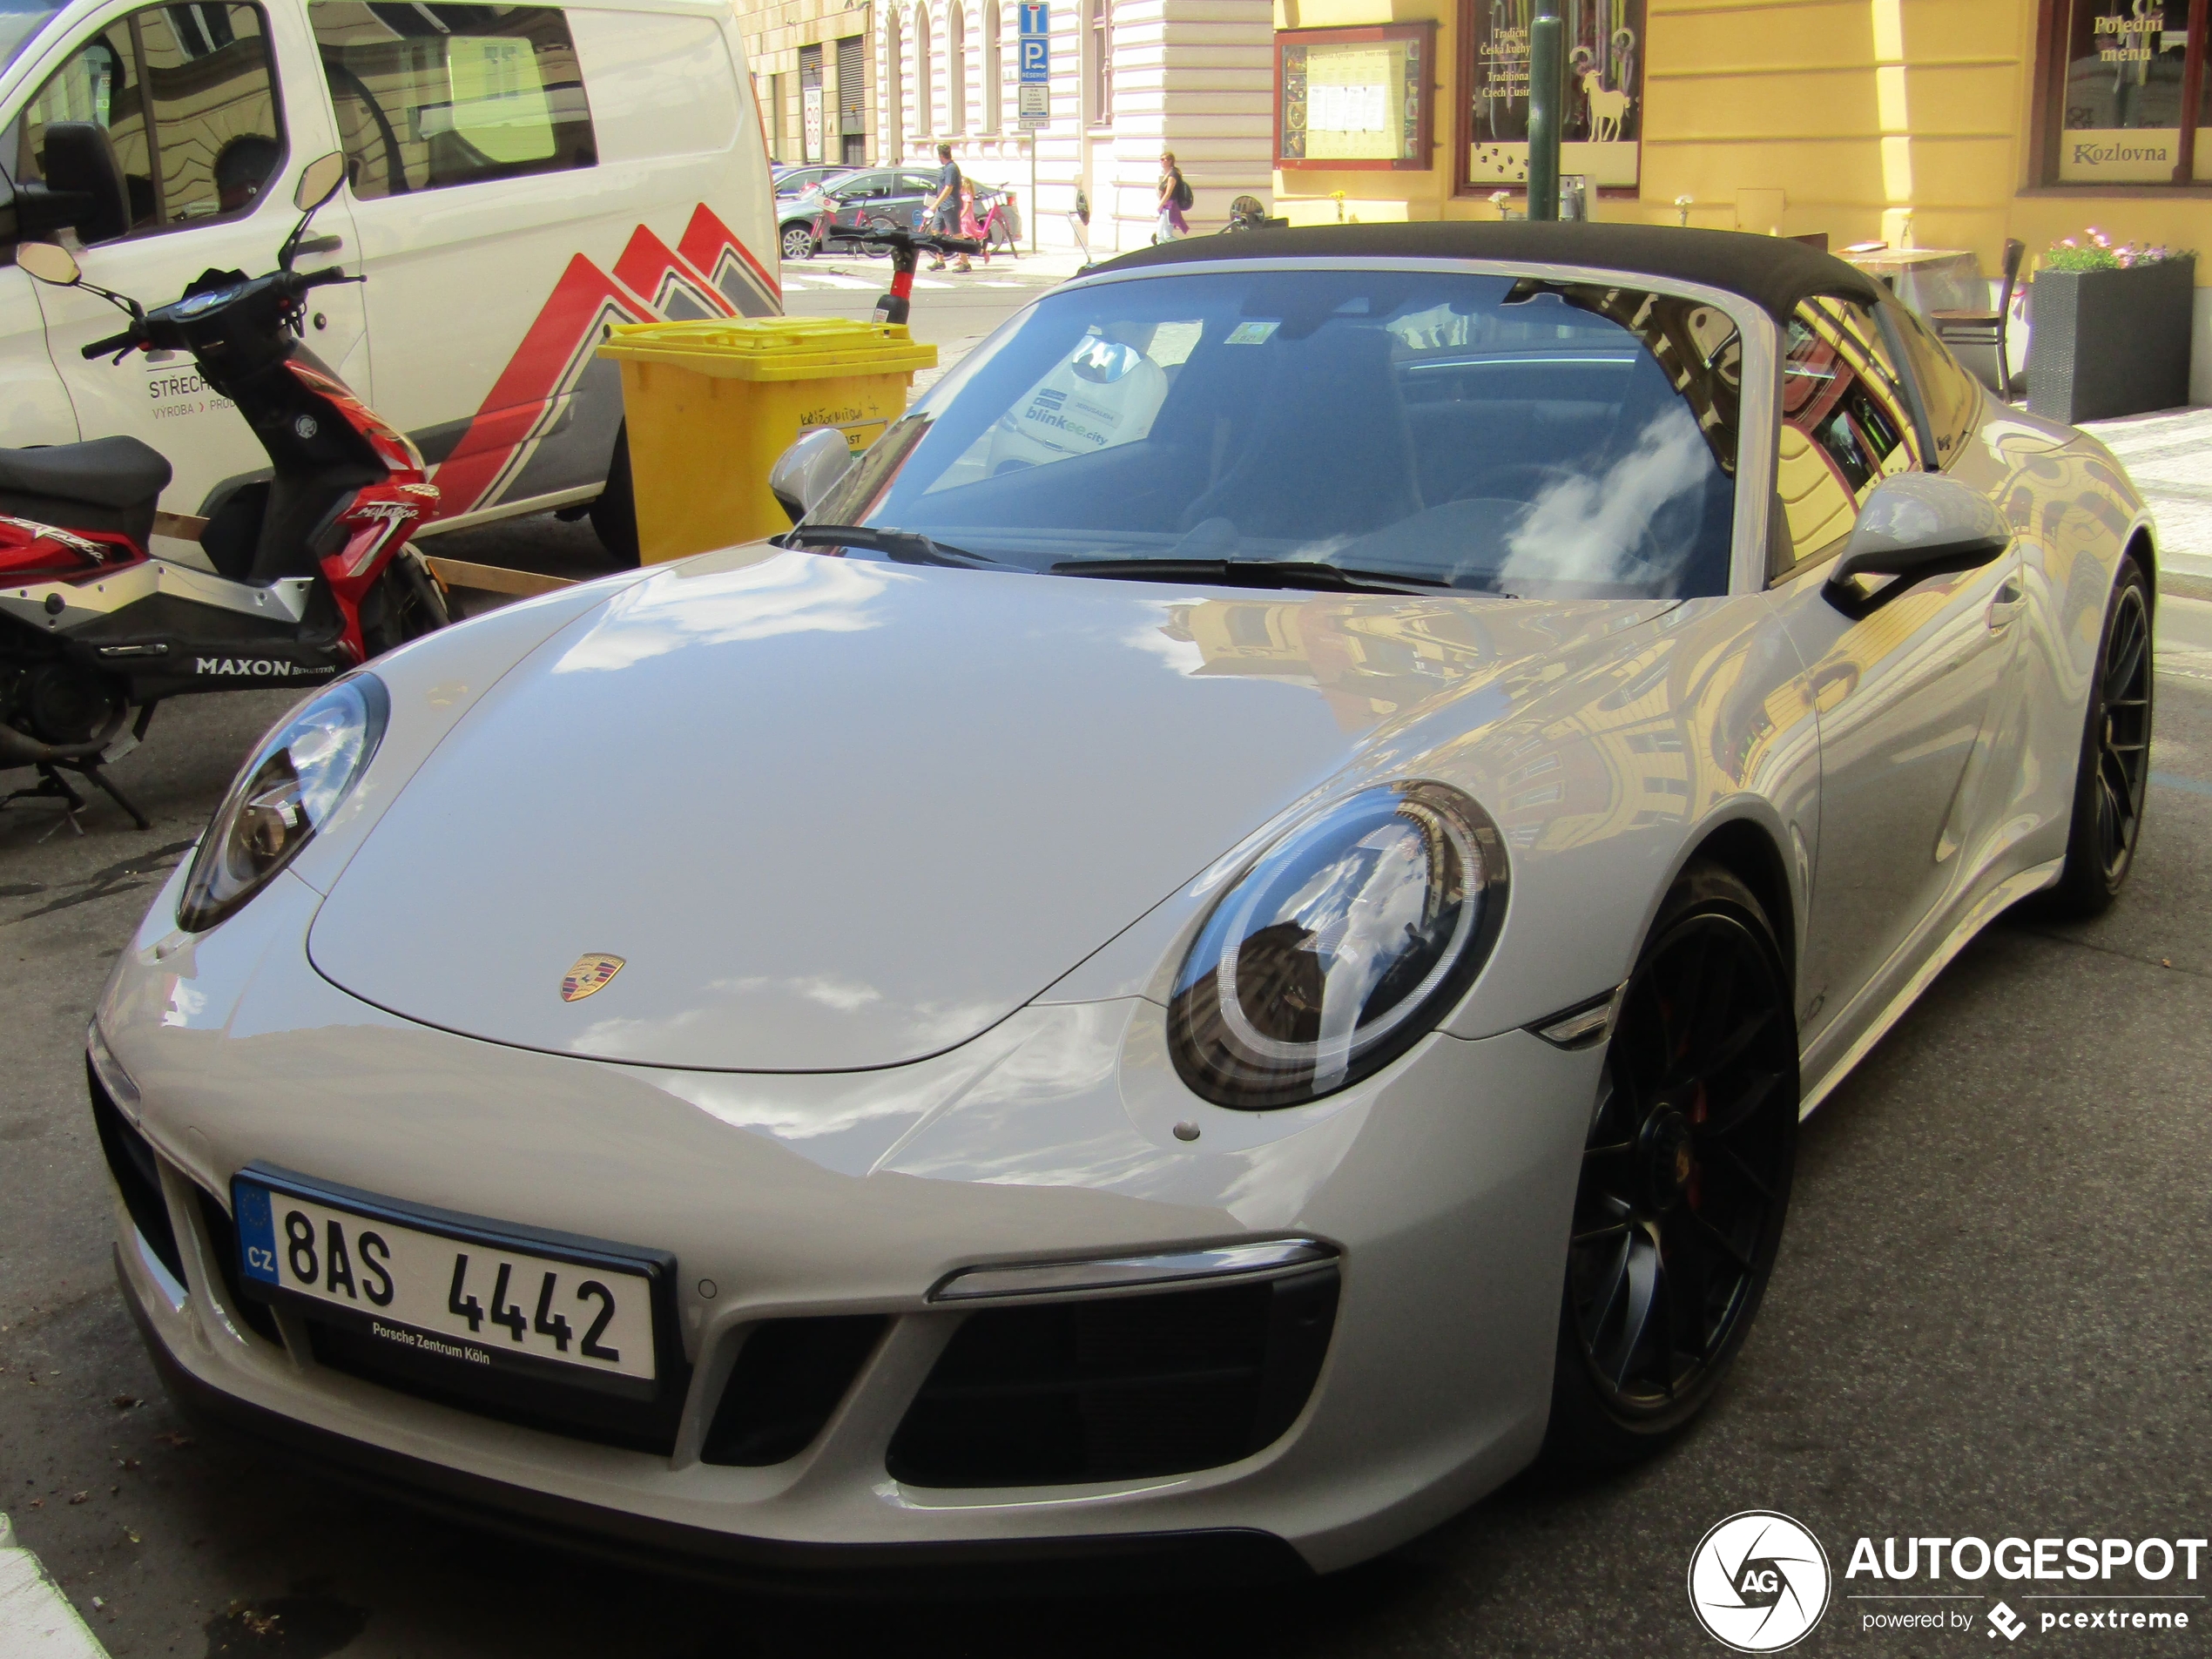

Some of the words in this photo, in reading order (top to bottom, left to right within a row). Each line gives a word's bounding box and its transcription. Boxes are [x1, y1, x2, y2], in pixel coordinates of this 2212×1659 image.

[2093, 13, 2164, 34] Polední
[2100, 47, 2153, 62] menu
[1482, 86, 1507, 98] Czech
[2073, 143, 2168, 165] Kozlovna
[197, 658, 291, 677] MAXON
[247, 1246, 274, 1271] CZ
[285, 1210, 395, 1307] 8AS
[448, 1252, 619, 1362] 4442
[373, 1321, 415, 1345] Porsche
[416, 1333, 462, 1358] Zentrum
[464, 1346, 490, 1365] Köln
